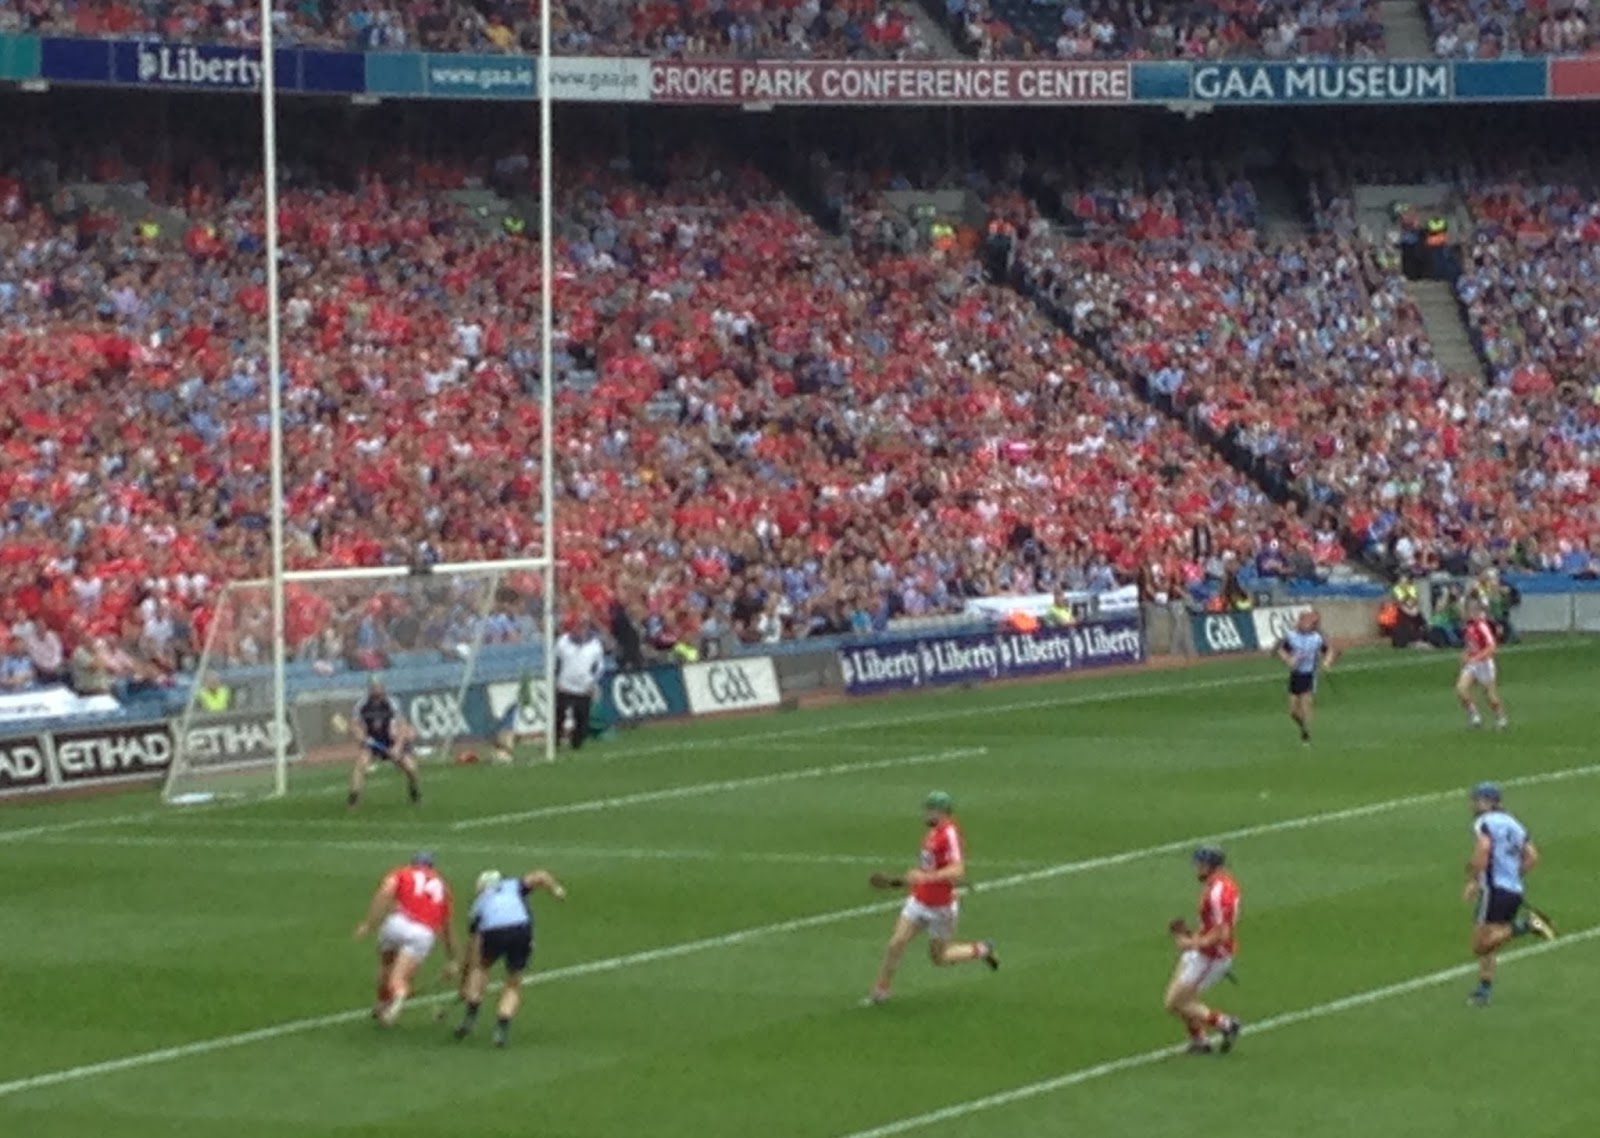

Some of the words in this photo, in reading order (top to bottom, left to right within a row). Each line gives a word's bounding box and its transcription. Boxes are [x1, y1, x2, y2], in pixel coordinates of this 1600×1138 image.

[159, 47, 262, 91] Liberty
[431, 65, 533, 90] www.gaa.ie
[649, 66, 734, 96] CROKE
[740, 67, 814, 97] PARK
[821, 67, 1007, 98] CONFERENCE
[1018, 67, 1127, 98] CENTRE
[1195, 67, 1275, 98] GAA
[1285, 65, 1448, 97] MUSEUM
[852, 649, 920, 685] Liberty
[934, 640, 998, 678] Liberty
[1011, 634, 1071, 668] Liberty
[1083, 625, 1140, 660] Liberty
[412, 870, 445, 904] 14
